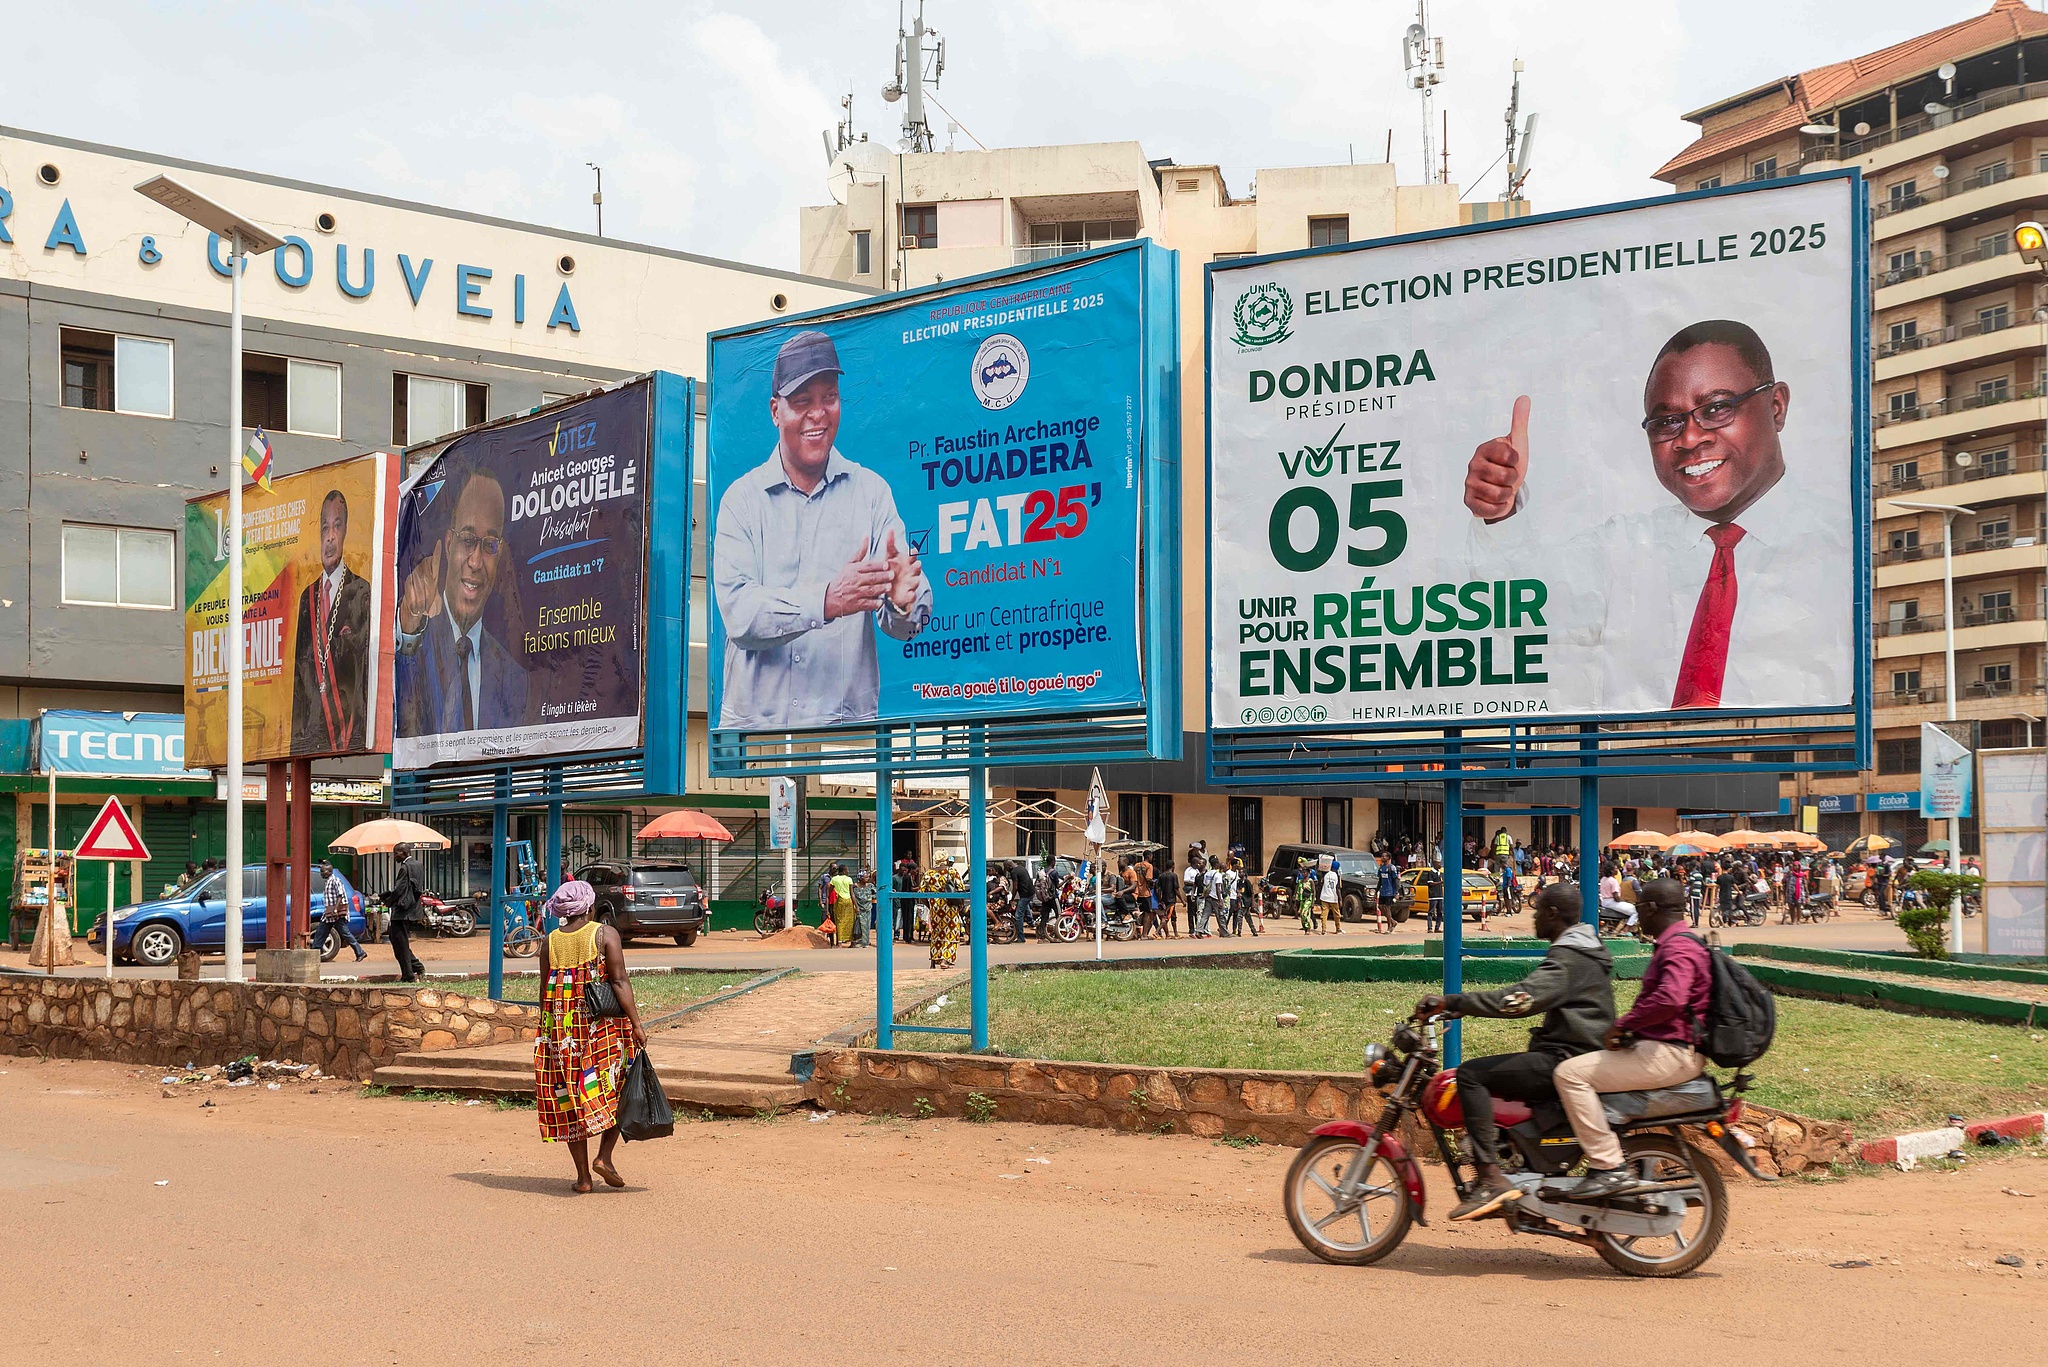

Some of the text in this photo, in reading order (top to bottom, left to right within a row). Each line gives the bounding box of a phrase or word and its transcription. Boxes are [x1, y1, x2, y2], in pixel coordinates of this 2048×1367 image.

[139, 236, 162, 264] &
[208, 230, 580, 332] GOUVEIA
[1305, 222, 1826, 316] ELECTION PRESIDENTIELLE 2025
[930, 282, 1073, 321] REPUBLIQUE CENTRAFRICAINE
[1250, 282, 1276, 294] UNIR
[902, 293, 1104, 344] ELECTION PRESIDENTIELLE 2025
[1249, 349, 1436, 402] DONDRA
[1286, 394, 1397, 421] PRÉSIDENT
[909, 416, 1100, 459] Pr. Faustin Archange
[530, 454, 615, 487] Anicet Georges
[921, 439, 1093, 491] TOUADERA
[1278, 434, 1402, 480] VOTEZ
[511, 459, 636, 522] DOLOGUÉLÉ
[276, 503, 286, 521] DES
[288, 500, 306, 517] CHEFS
[273, 523, 281, 539] LA
[281, 519, 301, 537] CEMAC
[540, 506, 598, 546] Président
[1268, 479, 1408, 573] 05
[263, 540, 286, 551] Septembre
[533, 557, 604, 584] Candidat n°7
[945, 557, 1062, 587] Candidat N°1
[195, 589, 279, 613] LE PEUPLE TRAFRICAIN
[206, 606, 267, 625] VOUS SAITE LA
[539, 597, 602, 627] Ensemble
[965, 611, 986, 629] un
[990, 599, 1104, 627] Centrafrique
[1239, 596, 1296, 620] UNIR
[1313, 576, 1548, 640] RÉUSSIR
[192, 617, 283, 677] BIENENUE
[524, 623, 616, 654] faisons mieux
[902, 621, 1112, 660] émergent et prospère.
[1239, 621, 1308, 645] POUR
[206, 674, 229, 684] AGRÉABL
[250, 671, 259, 679] SUR
[267, 667, 282, 676] TERRE
[1239, 634, 1548, 697] ENSEMBLE
[952, 685, 961, 696] a
[963, 680, 996, 701] goué
[999, 678, 1009, 695] ti
[1011, 677, 1025, 693] lo
[1028, 673, 1064, 695] goué
[567, 702, 573, 714] ti
[1352, 699, 1550, 719] HENRI-MARIE DONDRA
[49, 730, 185, 762] TECNO
[445, 737, 466, 748] seront
[467, 735, 476, 745] les
[505, 734, 512, 743] et
[512, 732, 522, 741] les
[522, 730, 548, 742] premiers
[549, 728, 568, 739] seront
[569, 727, 579, 736] les
[481, 748, 505, 756] Matthieu
[1819, 798, 1841, 808] obank
[1879, 795, 1909, 805] Ecobank
